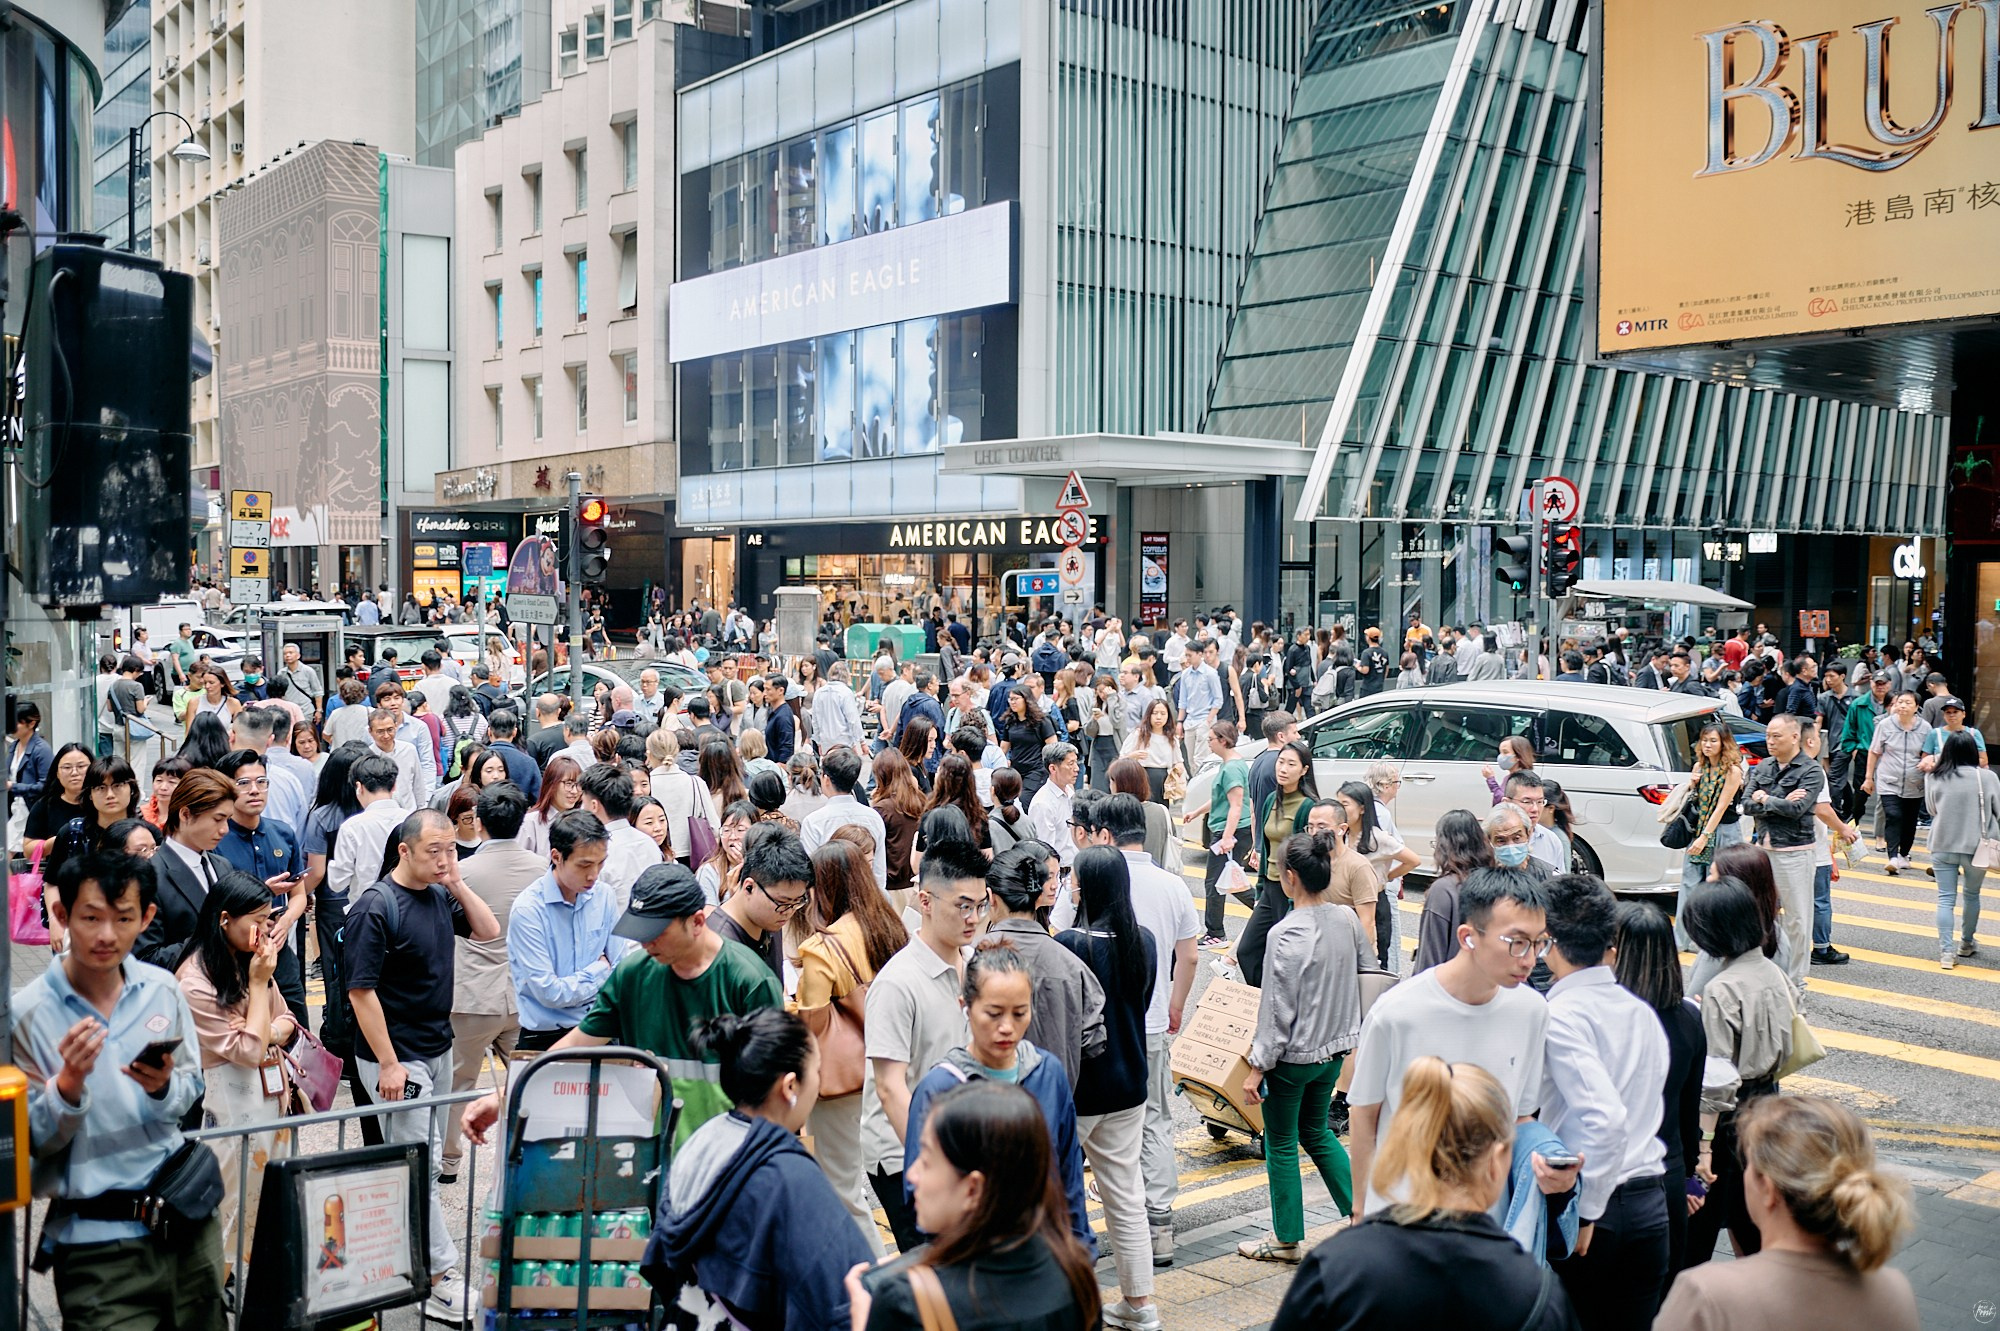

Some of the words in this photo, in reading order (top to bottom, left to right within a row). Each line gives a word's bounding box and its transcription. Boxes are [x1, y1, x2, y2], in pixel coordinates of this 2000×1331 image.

[729, 277, 837, 322] AMERICAN
[850, 258, 921, 296] EAGLE
[1841, 302, 1872, 312] CHEUNG
[1873, 300, 1895, 310] KONG
[1896, 296, 1932, 308] PROPERTY
[1934, 289, 1990, 303] DEVELOPMENT
[1634, 318, 1668, 333] MTR
[1737, 314, 1770, 324] HOLDINGS
[1771, 310, 1799, 320] LIMITED
[974, 448, 1003, 465] LHT
[1006, 444, 1063, 464] TOWER
[256, 523, 263, 531] 7
[416, 516, 471, 533] Homebake
[889, 521, 1007, 547] AMERICAN
[1020, 518, 1098, 545] EAGE
[256, 537, 268, 546] 12
[747, 534, 763, 545] AE
[1893, 536, 1926, 578] csl.
[255, 580, 261, 588] 7
[254, 593, 261, 602] 7
[1193, 1029, 1214, 1041] THERMAL
[1215, 1036, 1231, 1046] PAPER
[1203, 1024, 1219, 1034] ROLLS
[1182, 1053, 1198, 1063] ROLLS
[1172, 1059, 1192, 1071] THERMAL
[1193, 1065, 1210, 1076] PAPER
[553, 1080, 609, 1097] COINTRAU
[370, 1264, 395, 1283] 3,000
